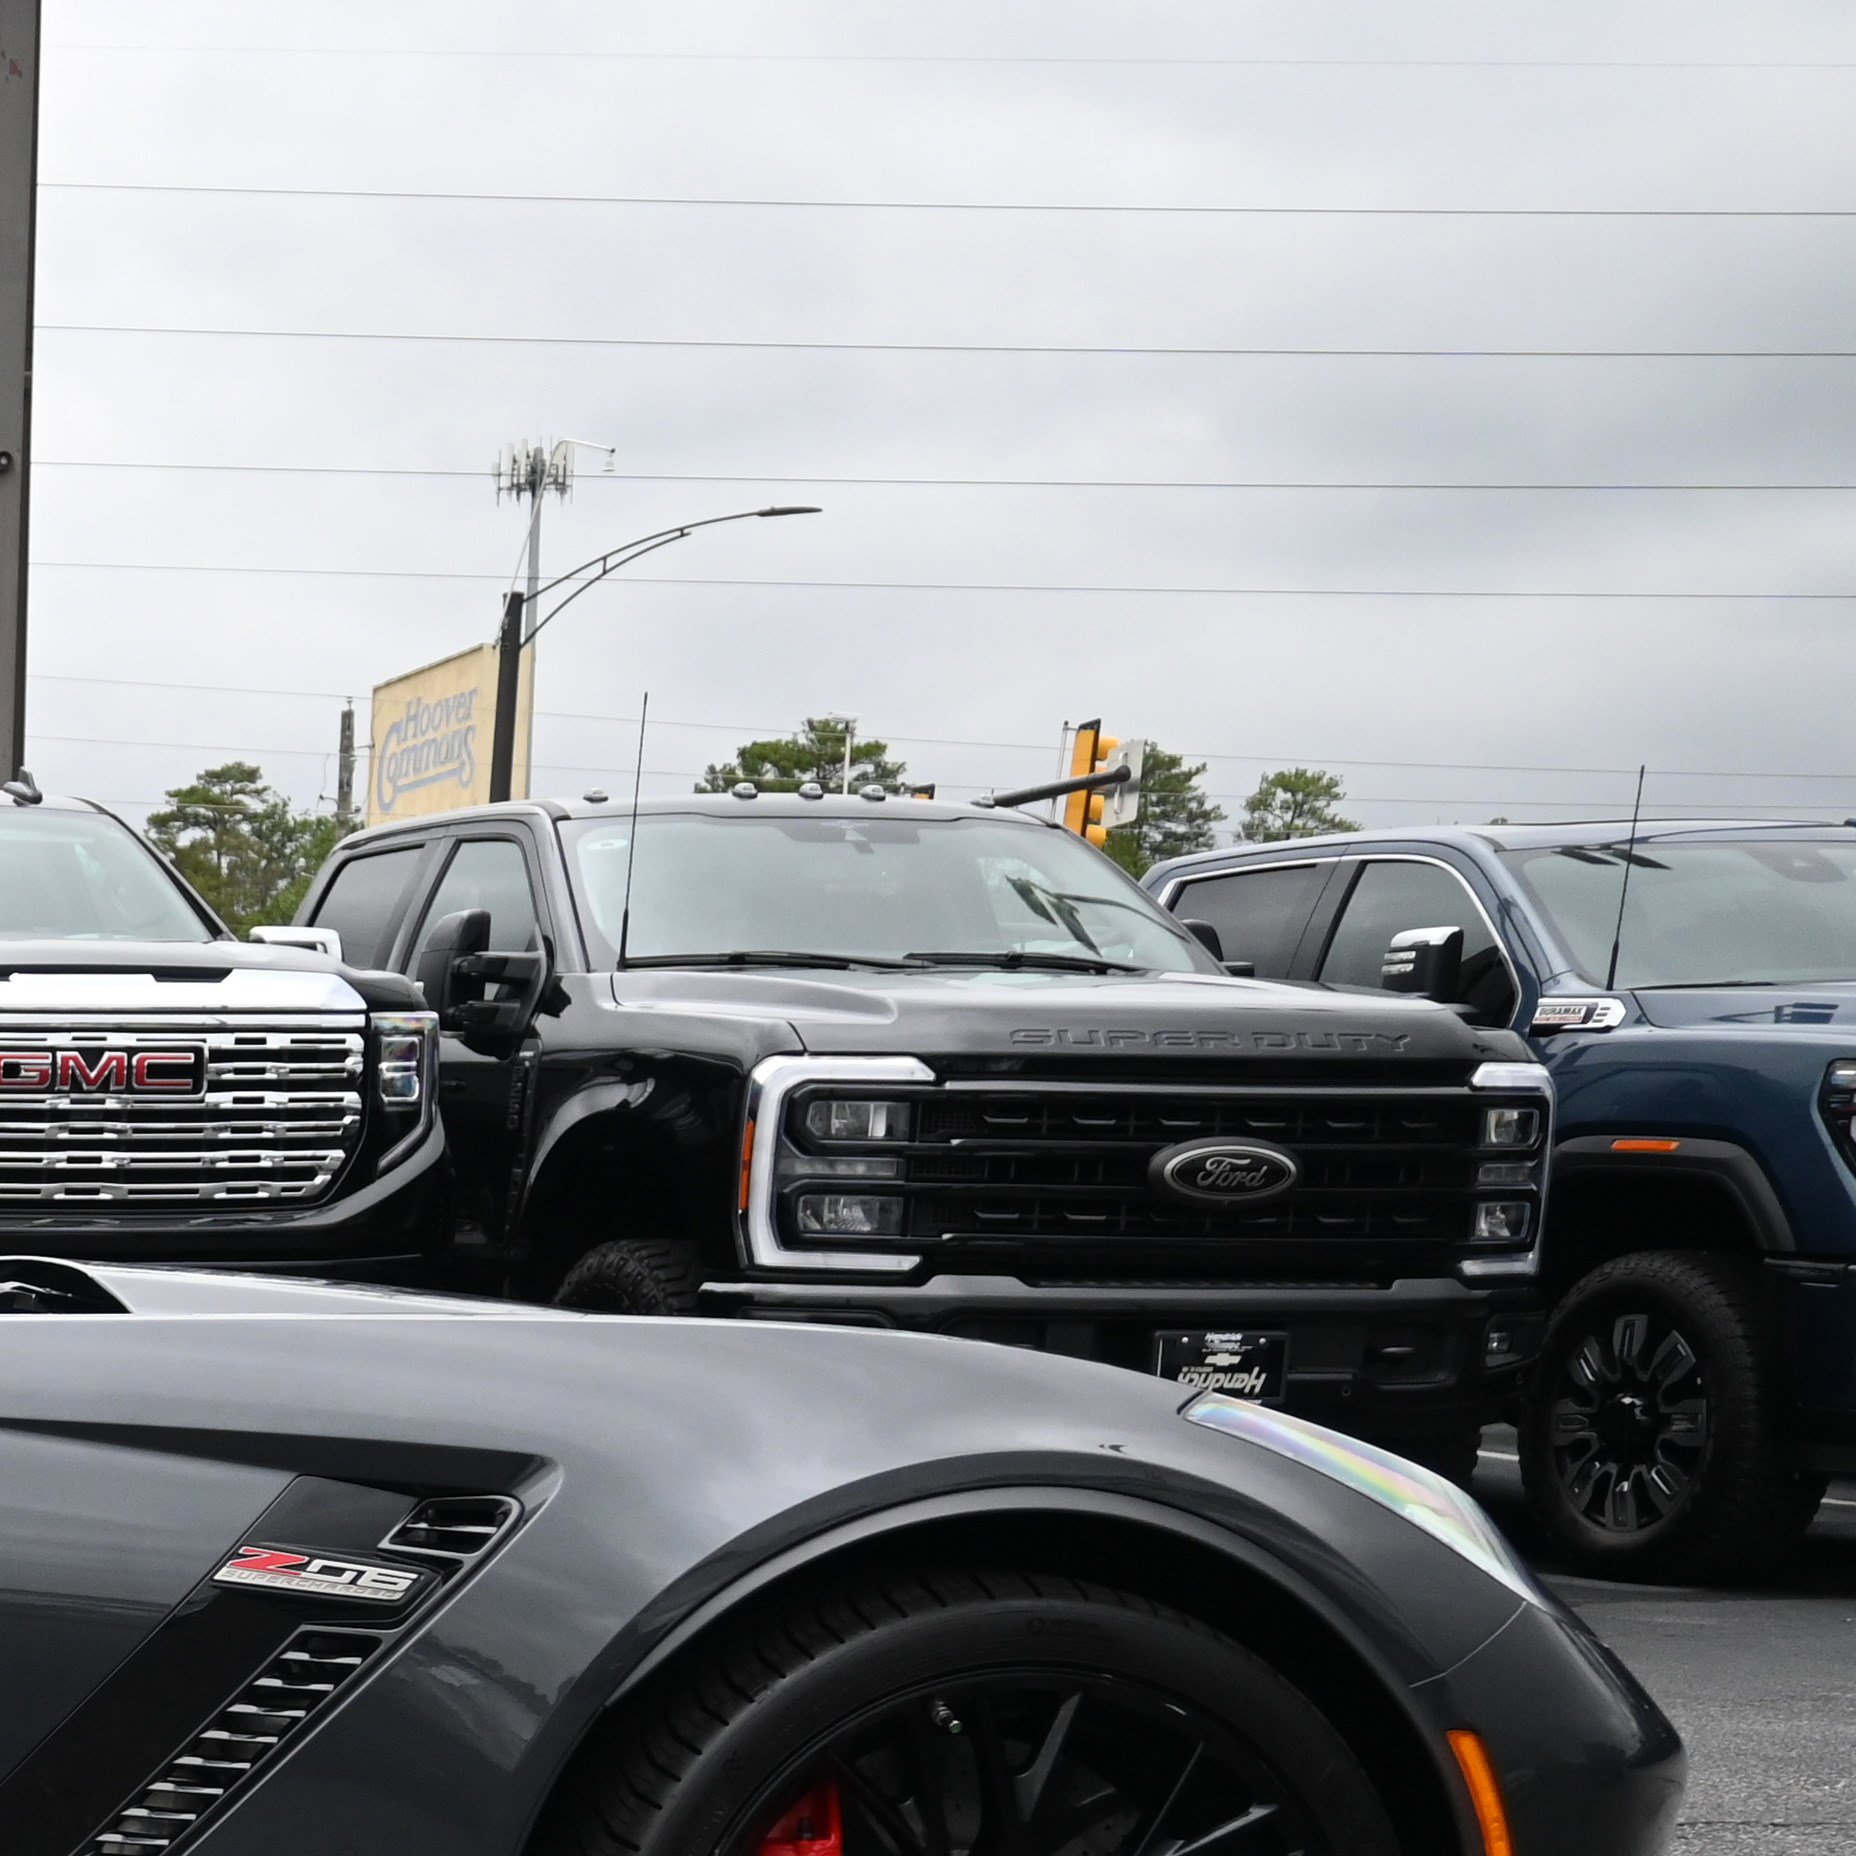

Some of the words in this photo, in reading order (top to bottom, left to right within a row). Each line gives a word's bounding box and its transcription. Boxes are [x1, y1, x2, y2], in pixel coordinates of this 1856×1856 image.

[402, 687, 478, 742] Hoover
[378, 719, 476, 814] Commons
[1009, 1028, 1239, 1048] SUPER
[1251, 1031, 1411, 1052] DUTY
[1196, 1156, 1269, 1187] Ford
[220, 1568, 398, 1598] SUPERCHARGED
[226, 1546, 419, 1592] Z06
